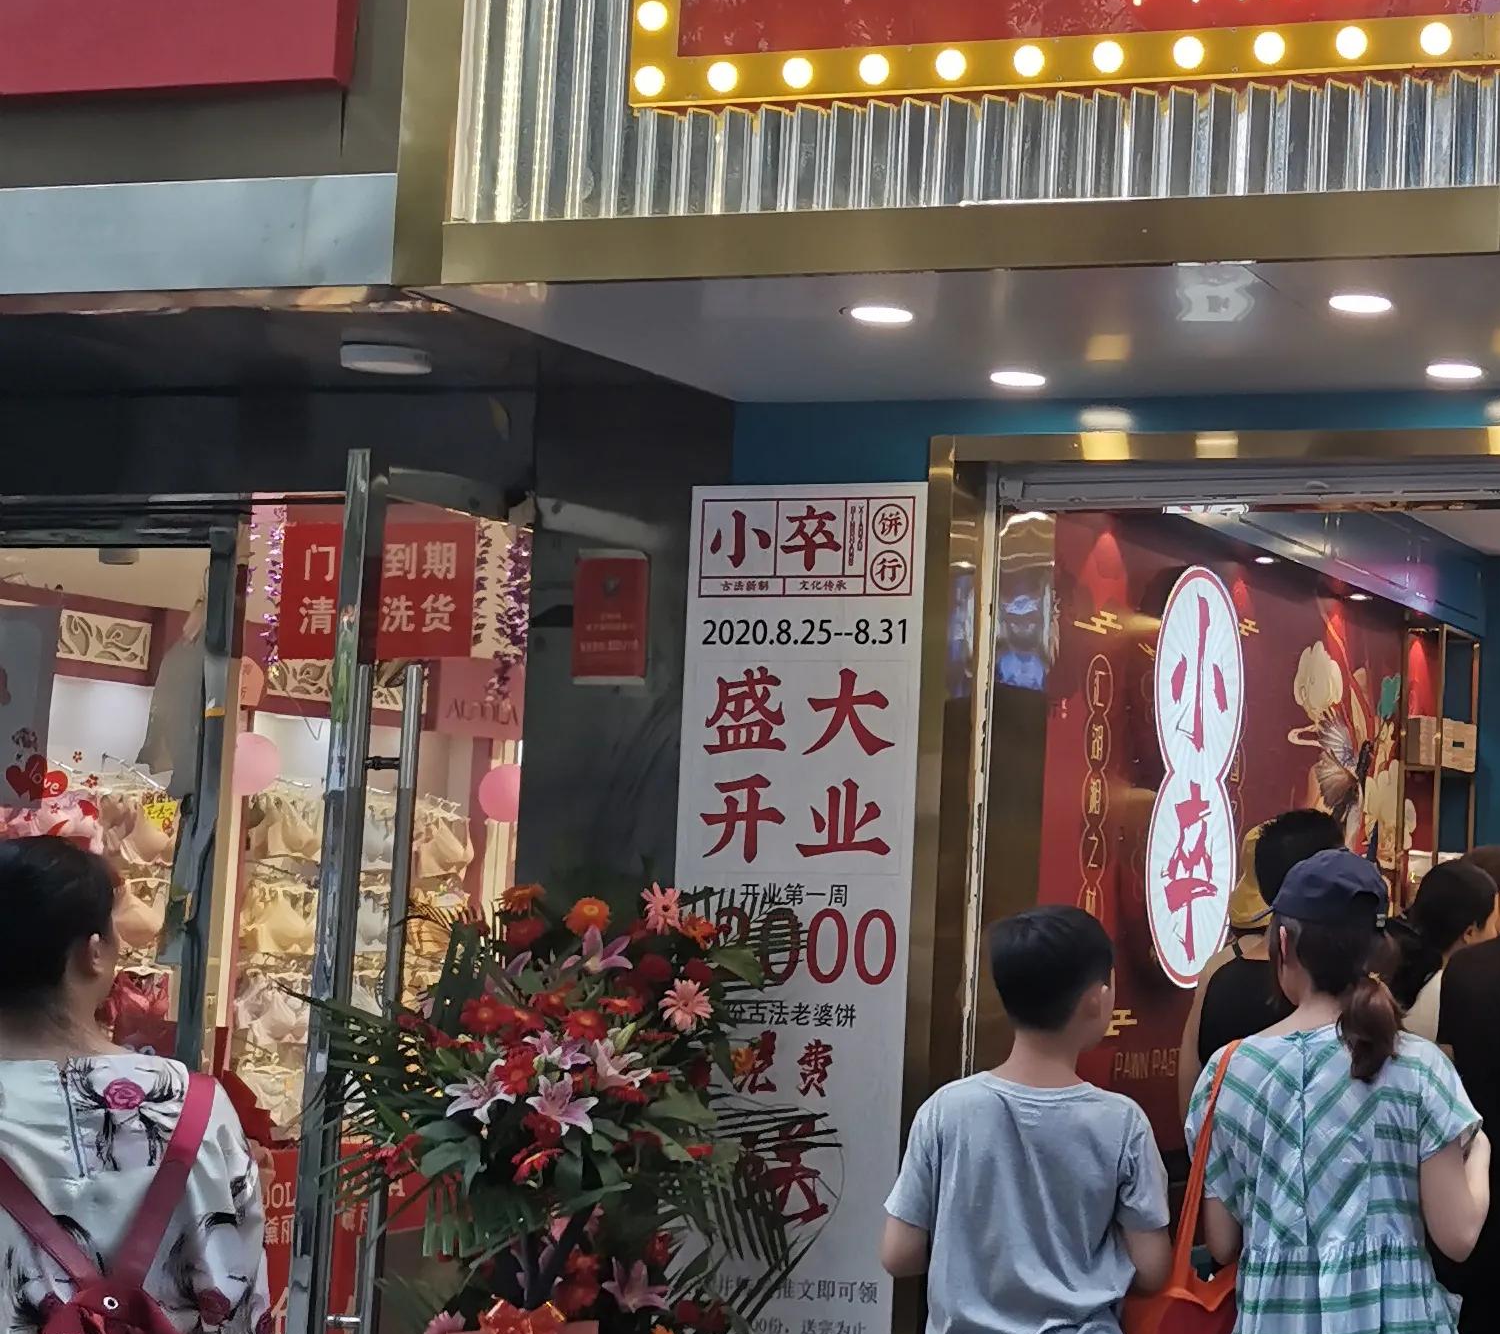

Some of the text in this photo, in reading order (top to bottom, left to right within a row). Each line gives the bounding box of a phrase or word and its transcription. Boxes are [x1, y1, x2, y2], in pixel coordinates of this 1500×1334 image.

[304, 541, 457, 582] 门到期
[710, 505, 842, 572] 小卒
[299, 593, 456, 636] 清洗货
[704, 666, 895, 757] 盛大
[700, 773, 891, 864] 开业
[740, 882, 848, 907] 开业第一周
